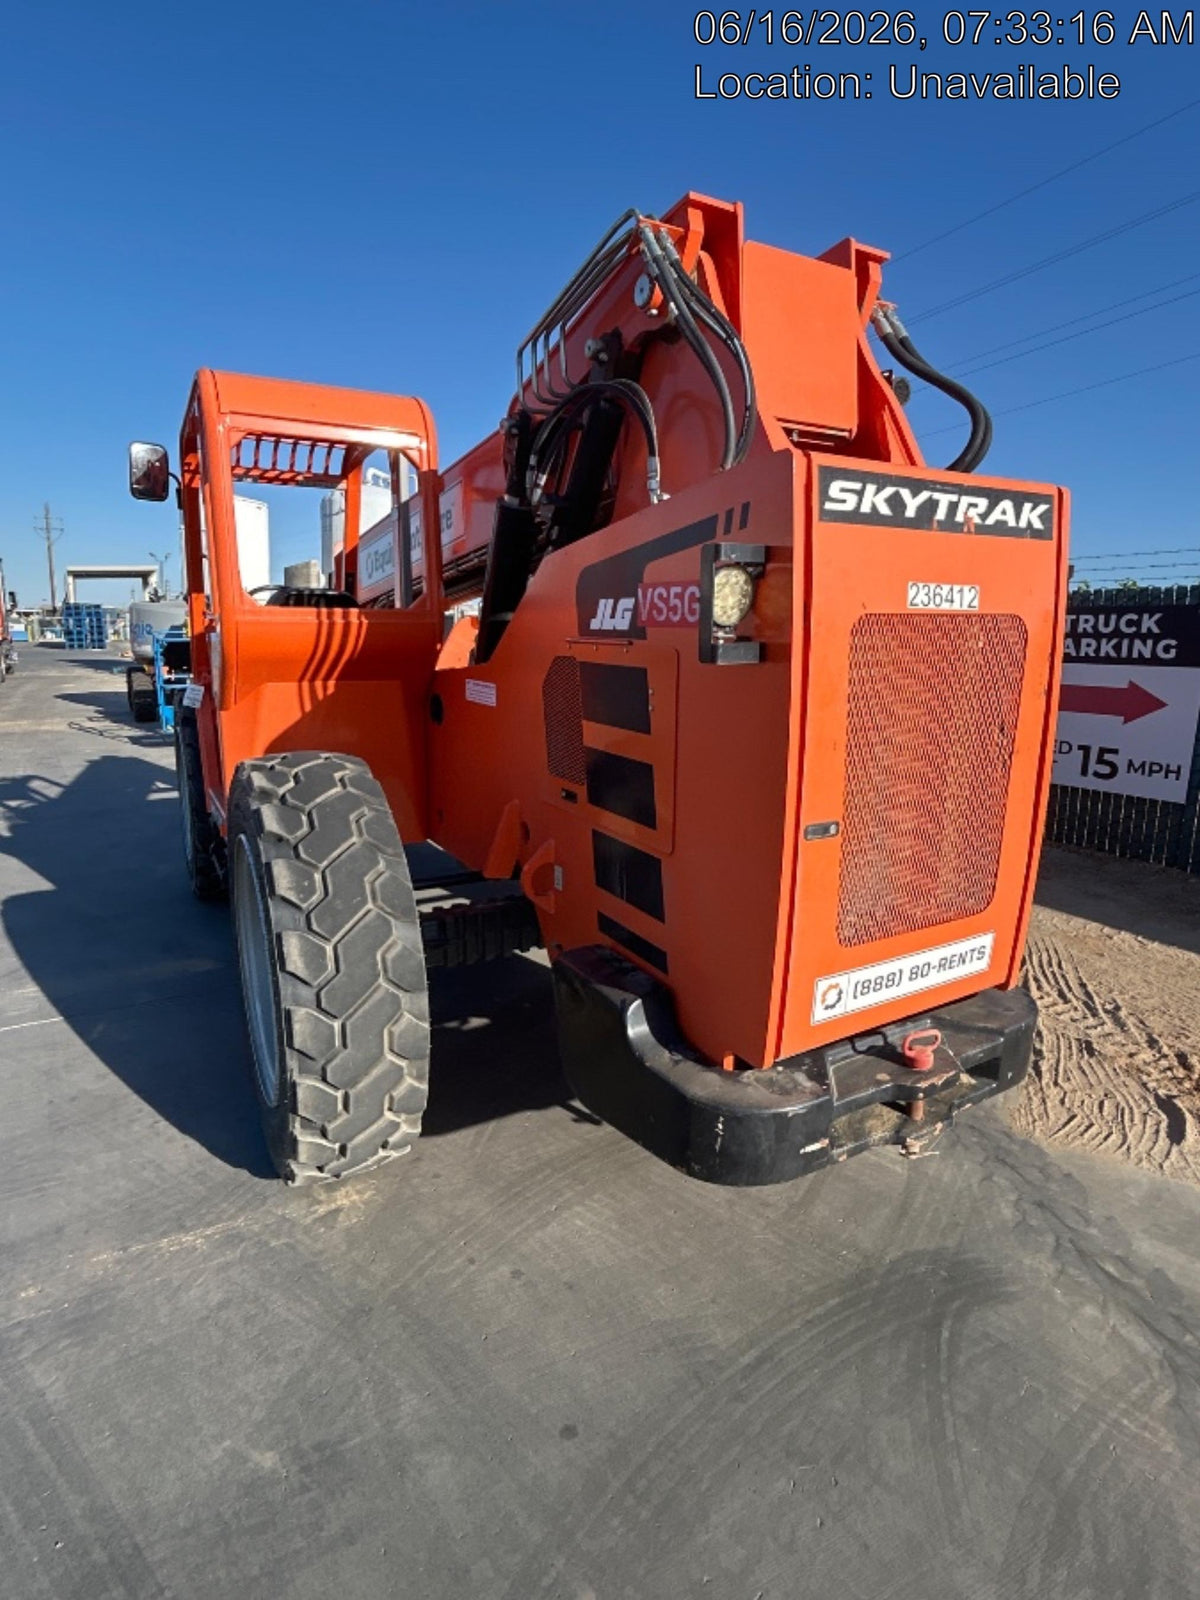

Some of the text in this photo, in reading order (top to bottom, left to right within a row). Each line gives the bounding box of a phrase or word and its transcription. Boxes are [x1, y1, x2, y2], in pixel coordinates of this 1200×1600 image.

[824, 479, 1050, 530] SKYTRAK
[909, 583, 979, 609] 236412
[589, 597, 636, 631] JLG
[1065, 613, 1164, 634] TRUCK
[1064, 637, 1179, 660] ARKING
[1077, 744, 1120, 781] 15
[1126, 758, 1182, 781] MPH
[852, 969, 904, 1000] (888)
